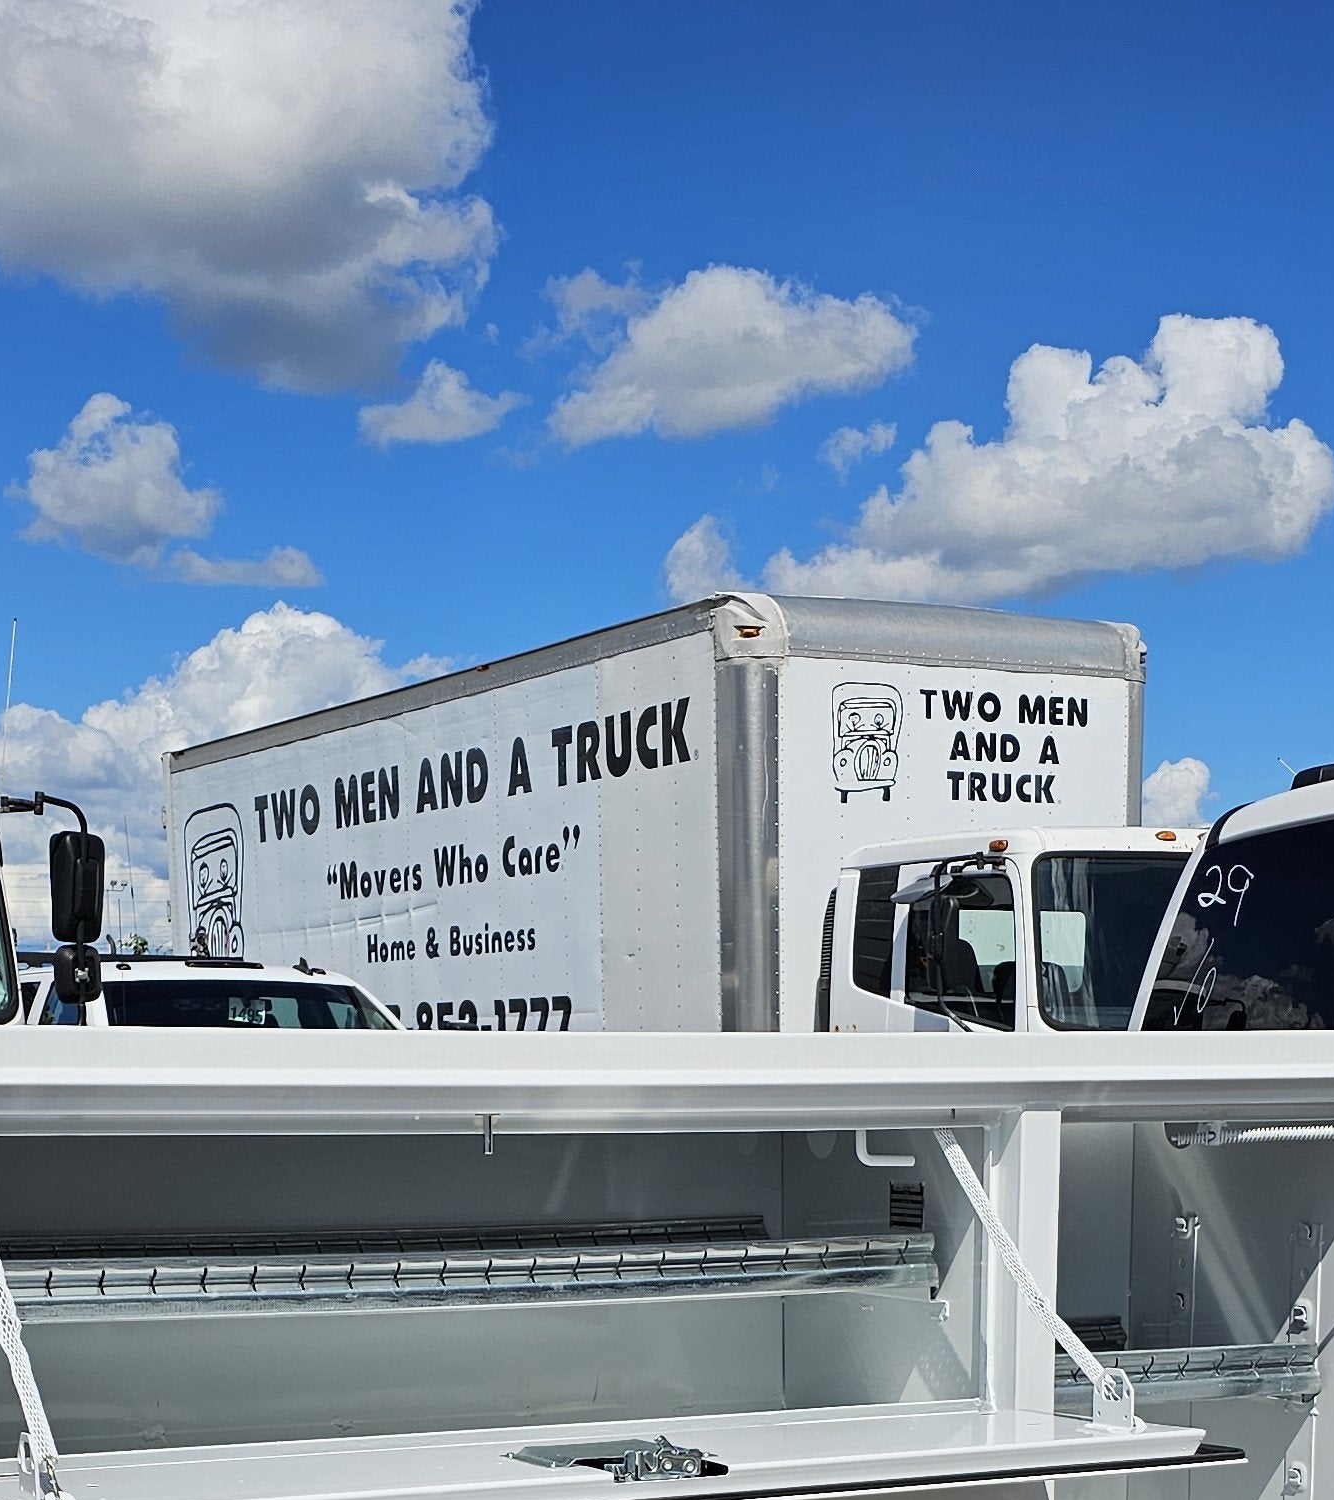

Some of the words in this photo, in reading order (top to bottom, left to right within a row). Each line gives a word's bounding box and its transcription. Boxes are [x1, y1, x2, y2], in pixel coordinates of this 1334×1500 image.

[920, 689, 1001, 722] TWO
[1018, 694, 1088, 727] MEN
[949, 730, 1020, 762] AND
[1038, 735, 1060, 765] A
[254, 784, 320, 843] TWO
[334, 765, 400, 829] MEN
[416, 747, 488, 814] AND
[507, 736, 533, 797] A
[551, 696, 691, 787] TRUCK
[946, 771, 1056, 804] TRUCK
[327, 860, 422, 900] “Movers
[433, 844, 489, 888] Who
[502, 824, 581, 878] Care”
[1197, 864, 1255, 927] 29
[367, 933, 416, 963] Home
[425, 926, 441, 959] &
[450, 922, 536, 957] Business
